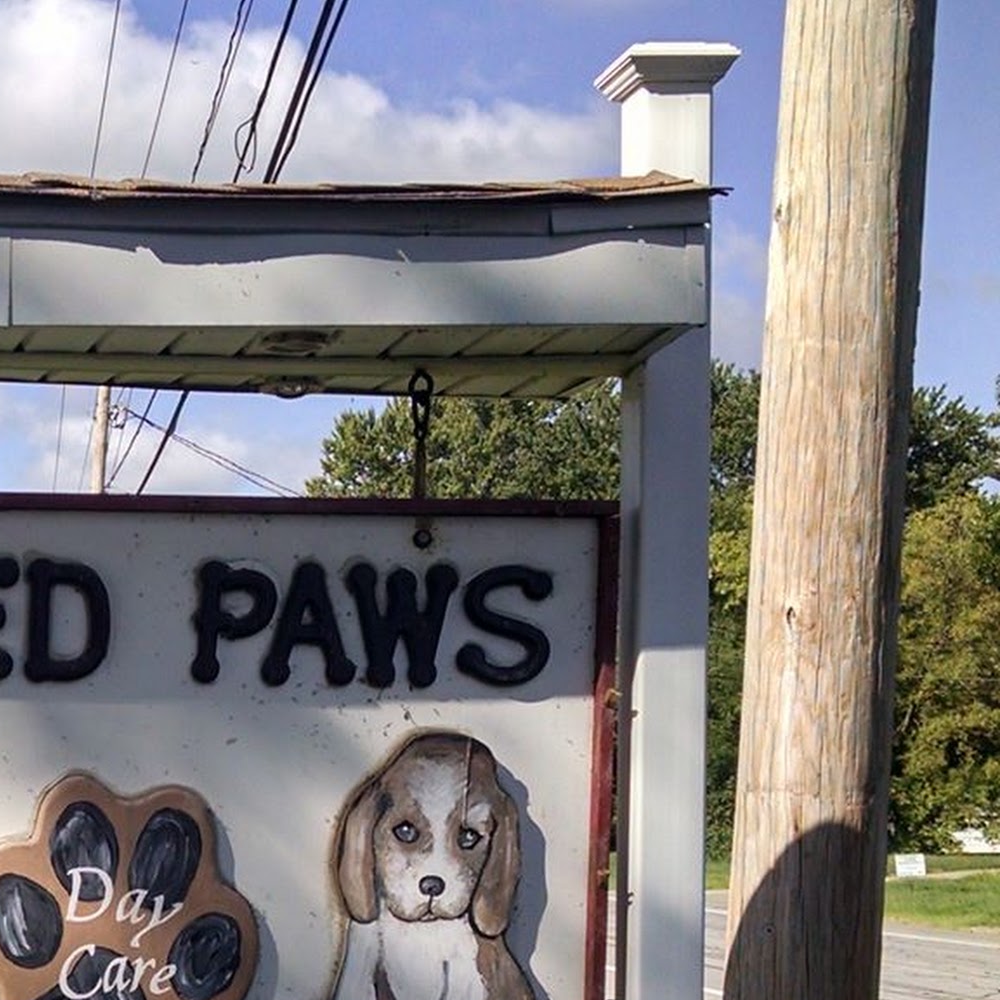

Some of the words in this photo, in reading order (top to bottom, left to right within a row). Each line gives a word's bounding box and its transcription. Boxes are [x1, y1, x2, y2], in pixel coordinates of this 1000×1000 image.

[190, 558, 554, 688] PAWS
[66, 866, 183, 948] Day
[58, 944, 177, 1000] Care
